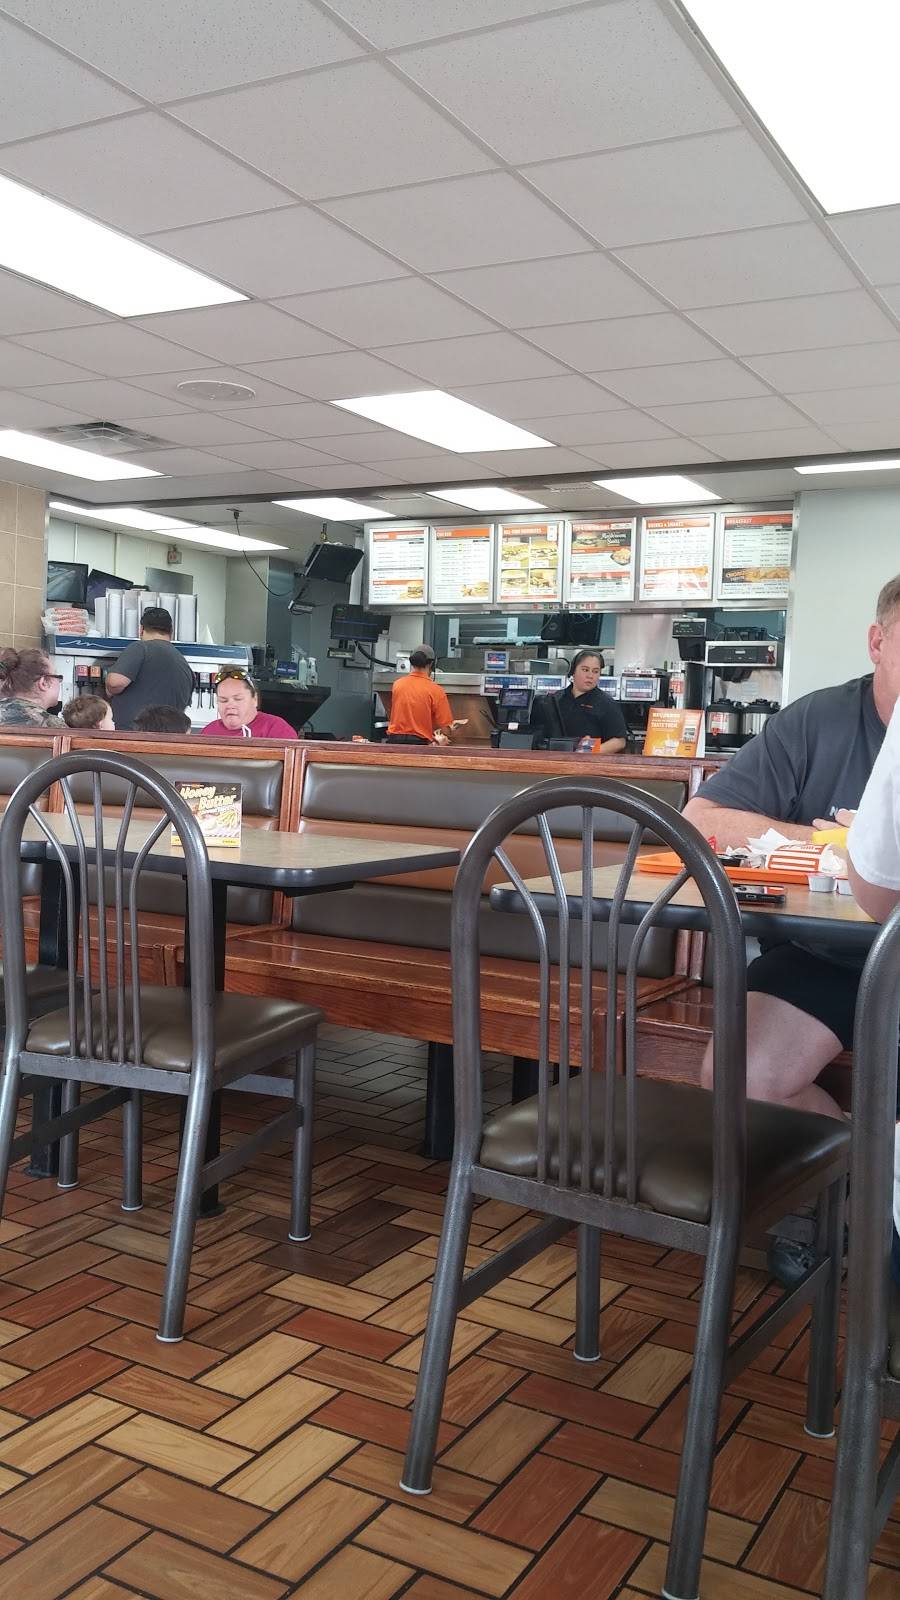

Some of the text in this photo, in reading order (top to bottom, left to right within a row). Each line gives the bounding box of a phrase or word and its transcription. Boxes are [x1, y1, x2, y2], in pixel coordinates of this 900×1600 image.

[671, 684, 681, 693] TEA
[180, 786, 217, 800] Honey
[198, 795, 237, 810] Butter
